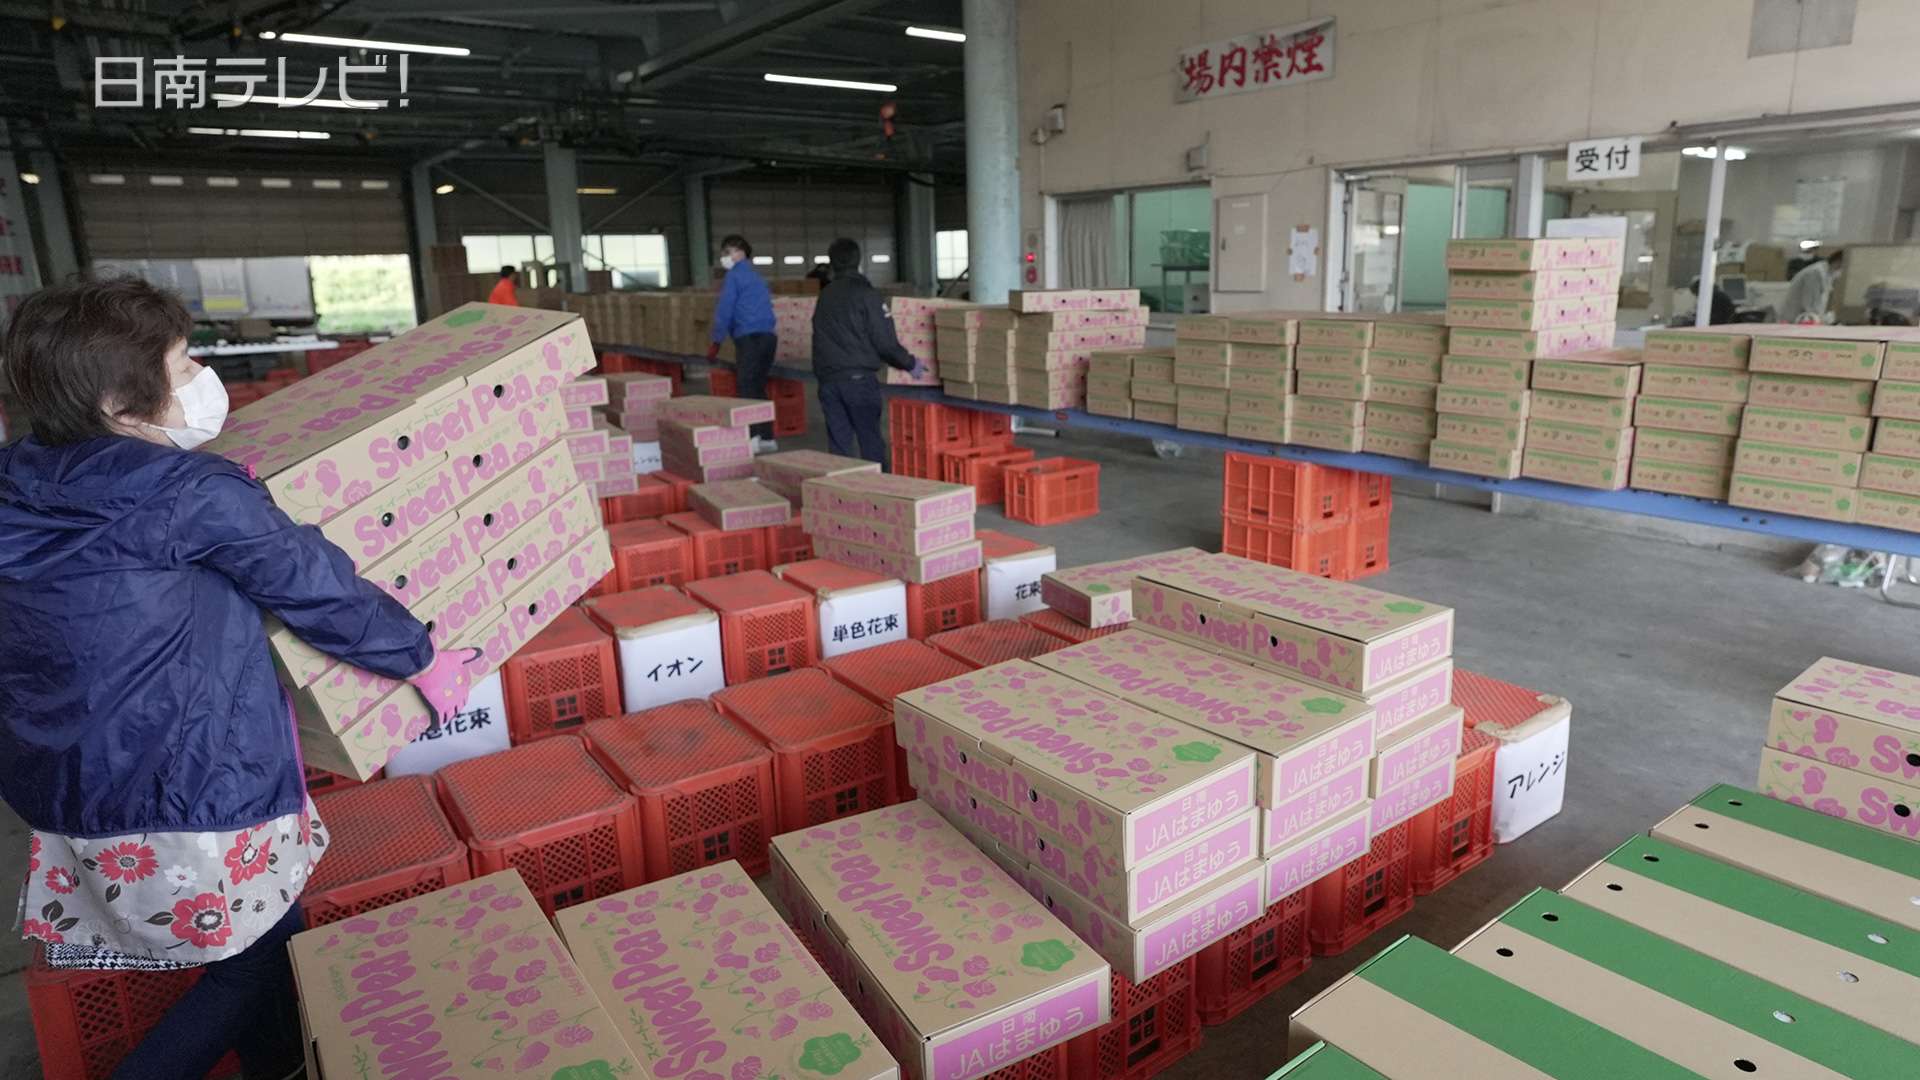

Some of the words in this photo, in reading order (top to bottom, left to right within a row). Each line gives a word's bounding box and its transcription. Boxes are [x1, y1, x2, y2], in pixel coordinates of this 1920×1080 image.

[1182, 32, 1324, 95] 場内禁煙
[1576, 145, 1630, 172] 受付
[368, 399, 474, 479] Sweet
[472, 374, 532, 425] Pea
[354, 470, 455, 557] Sweet
[452, 442, 510, 495] Pea
[463, 501, 519, 555] Pea
[430, 575, 490, 650] weet
[487, 542, 542, 596] Pea
[510, 587, 561, 641] Pea
[1015, 581, 1041, 600] 花束
[832, 613, 898, 642] 単色花束
[1181, 602, 1249, 650] Sweet
[1252, 623, 1298, 668] Pea
[648, 658, 703, 681] イオン
[410, 706, 491, 743] 花束
[963, 700, 1030, 733] Pea
[1002, 724, 1113, 774] Sweet
[1287, 740, 1363, 793] JAはまゆう
[1508, 750, 1564, 798] アレンジ
[943, 735, 1009, 808] Sweet
[1012, 771, 1061, 833] Pea
[1278, 785, 1354, 839] JAはまゆう
[954, 779, 1018, 847] Sweet
[1022, 819, 1067, 880] Pea
[1145, 790, 1239, 851] JAはまゆう
[831, 855, 895, 902] Pea
[1148, 841, 1241, 903] JAはまゆう
[1279, 837, 1358, 891] JAはまゆう
[612, 929, 679, 990] Pea
[852, 893, 954, 971] Sweet
[1155, 900, 1248, 965] JAはまゆう
[340, 950, 431, 1023] Pea
[350, 1003, 455, 1080] weet
[624, 977, 727, 1079] Sweet
[951, 1006, 1085, 1079] JAはまゆう
